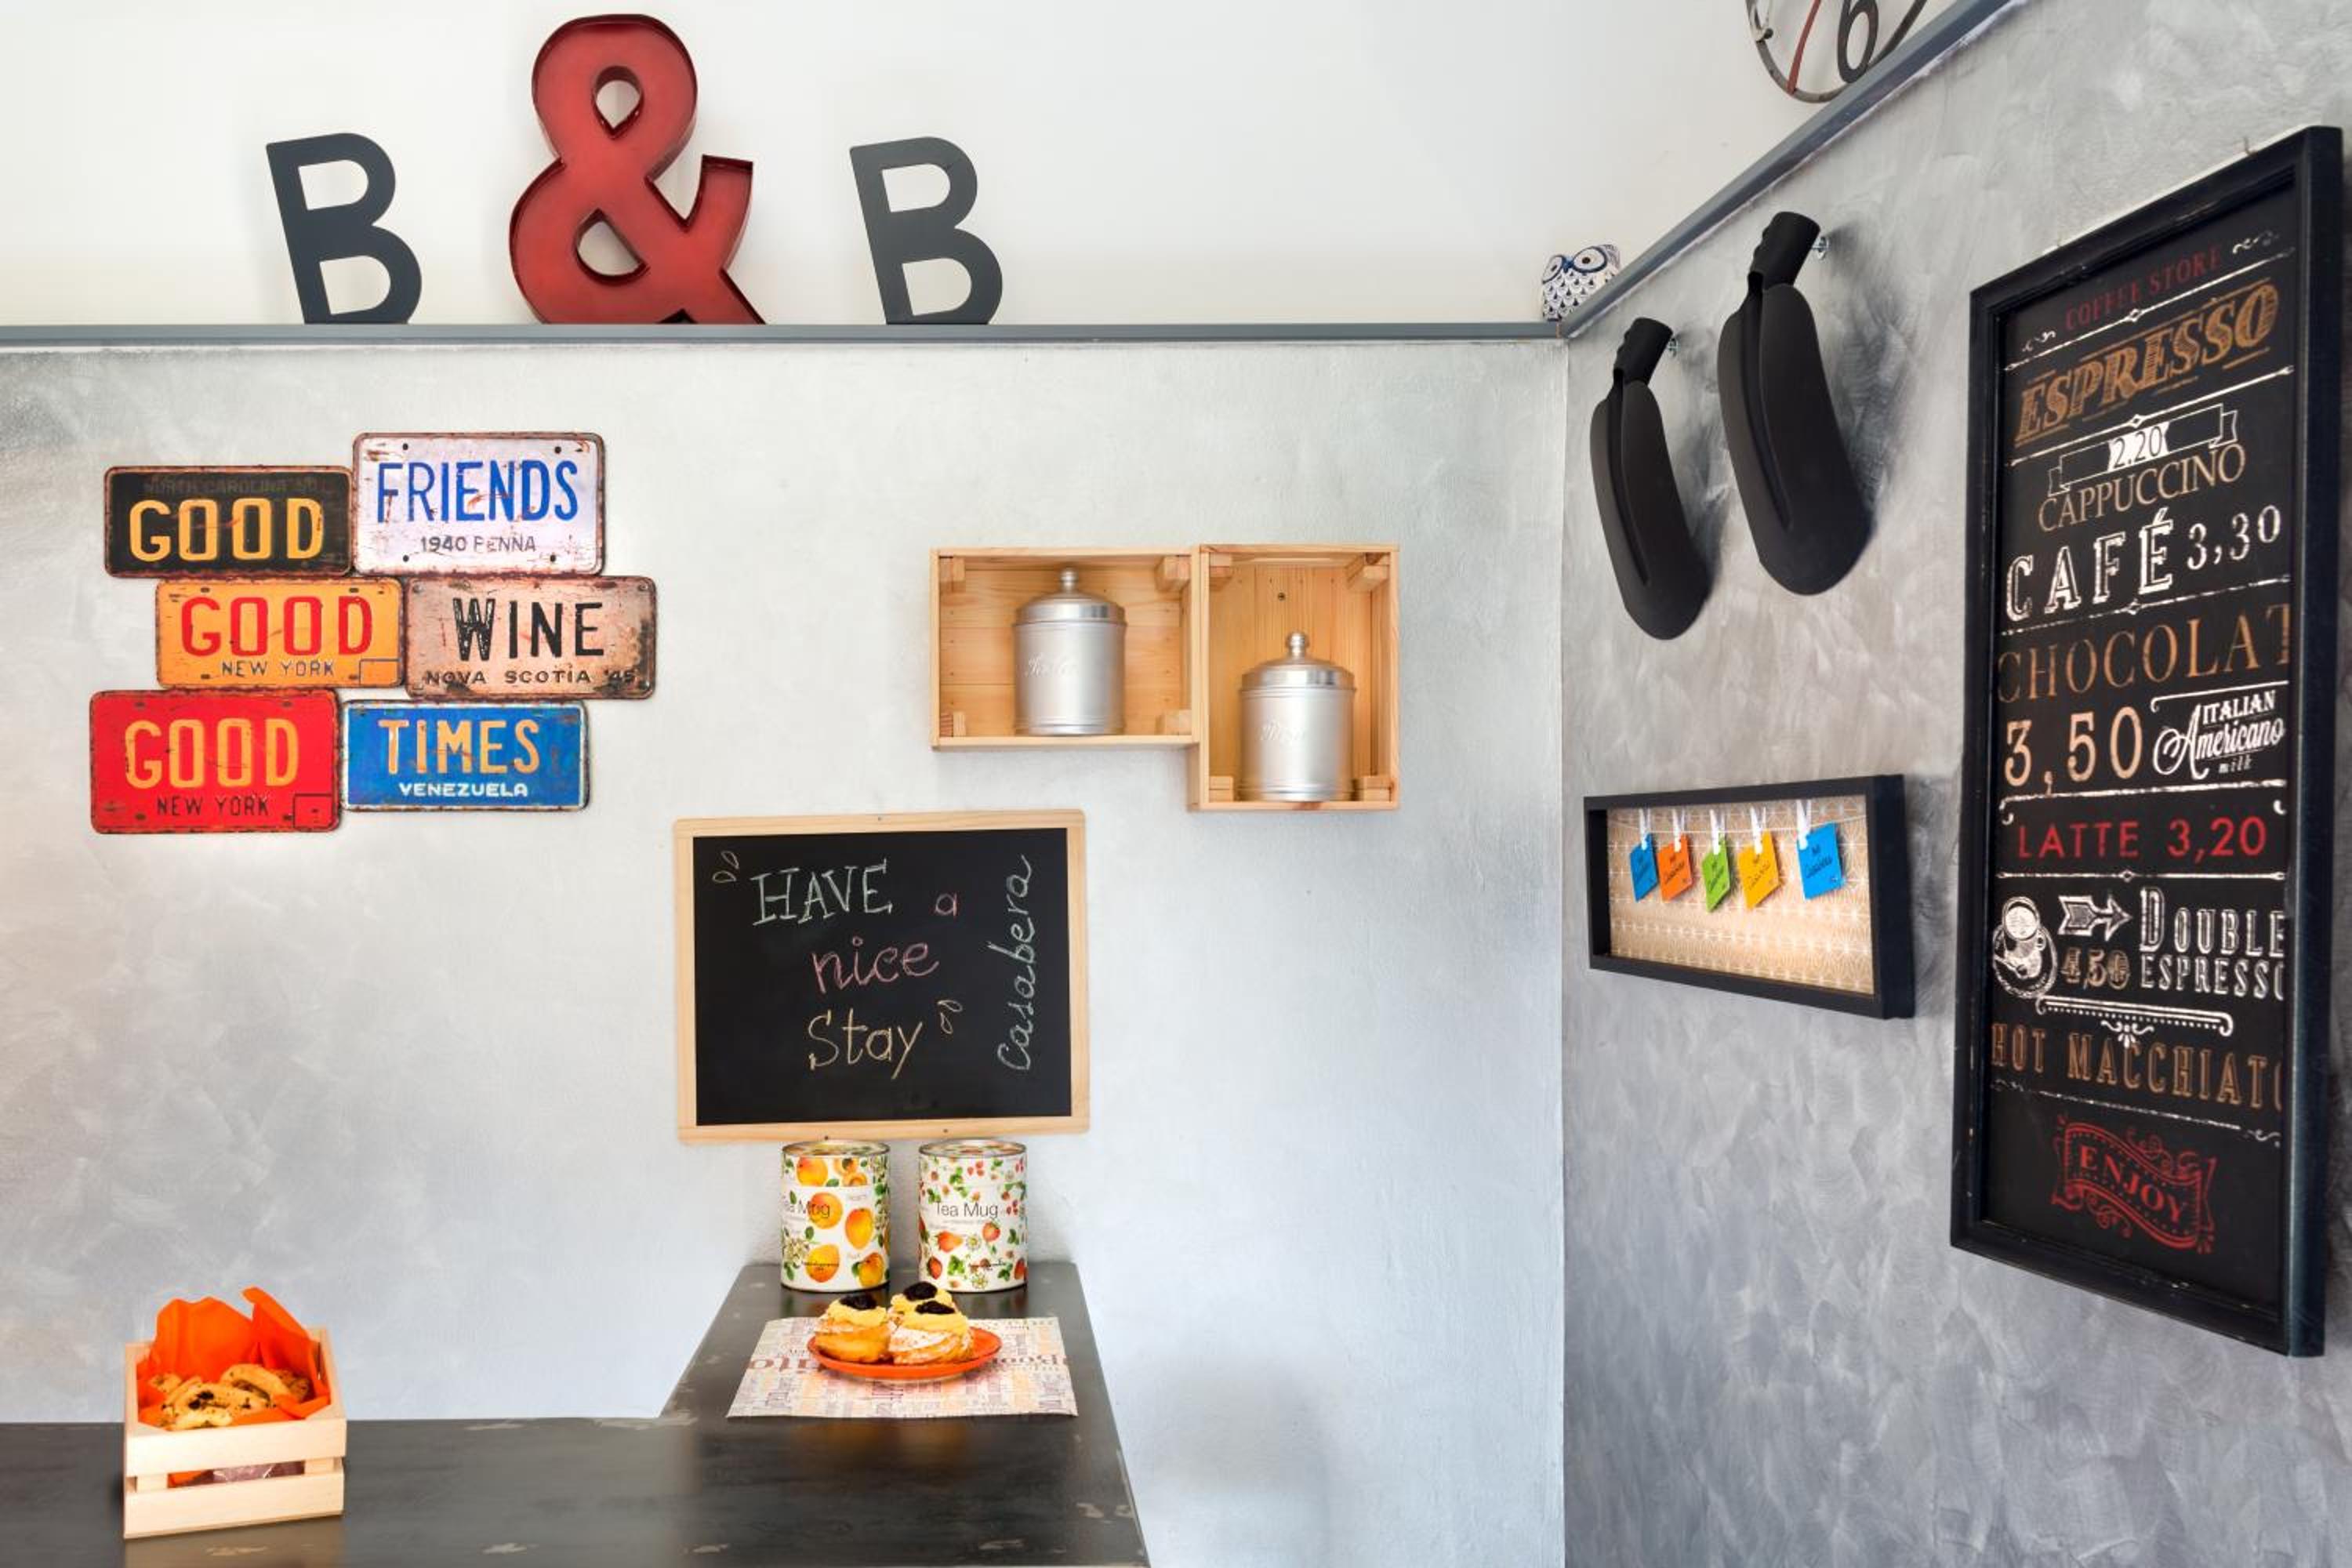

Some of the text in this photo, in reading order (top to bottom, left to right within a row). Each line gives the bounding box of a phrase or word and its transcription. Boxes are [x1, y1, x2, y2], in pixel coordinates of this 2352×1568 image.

[267, 13, 1003, 324] B & B
[2065, 245, 2221, 330] COFFEE STORE
[2017, 285, 2278, 441] ESPRESSO
[377, 459, 578, 523] FRIENDS
[2038, 444, 2245, 532] CAPPUCCINO
[129, 498, 324, 562] GOOD
[421, 535, 467, 553] 1940
[2006, 505, 2281, 621] CAFÉ 3,30
[181, 596, 373, 656] GOOD
[452, 597, 604, 662] WINE
[222, 661, 335, 677] NEW YORK
[424, 670, 486, 685] NOVA
[504, 670, 591, 684] SCOTIA
[2202, 690, 2276, 725] ITALIAN
[125, 718, 299, 789] GOOD
[378, 718, 540, 775] TIMES
[2005, 706, 2142, 797] 3,50
[2153, 704, 2286, 780] Americano
[2219, 754, 2253, 774] milk
[158, 795, 270, 816] NEW YORK
[398, 782, 528, 797] VENEZUELA
[2018, 816, 2267, 863] LATTE 3,20
[750, 858, 960, 926] HAVE a
[2139, 887, 2285, 957] DOUBLE
[811, 936, 939, 993] nice
[808, 1008, 923, 1080] Stay
[1991, 1023, 2046, 1073] HOT
[935, 1202, 999, 1219] Tea Mug
[2081, 1145, 2182, 1223] ENJOY
